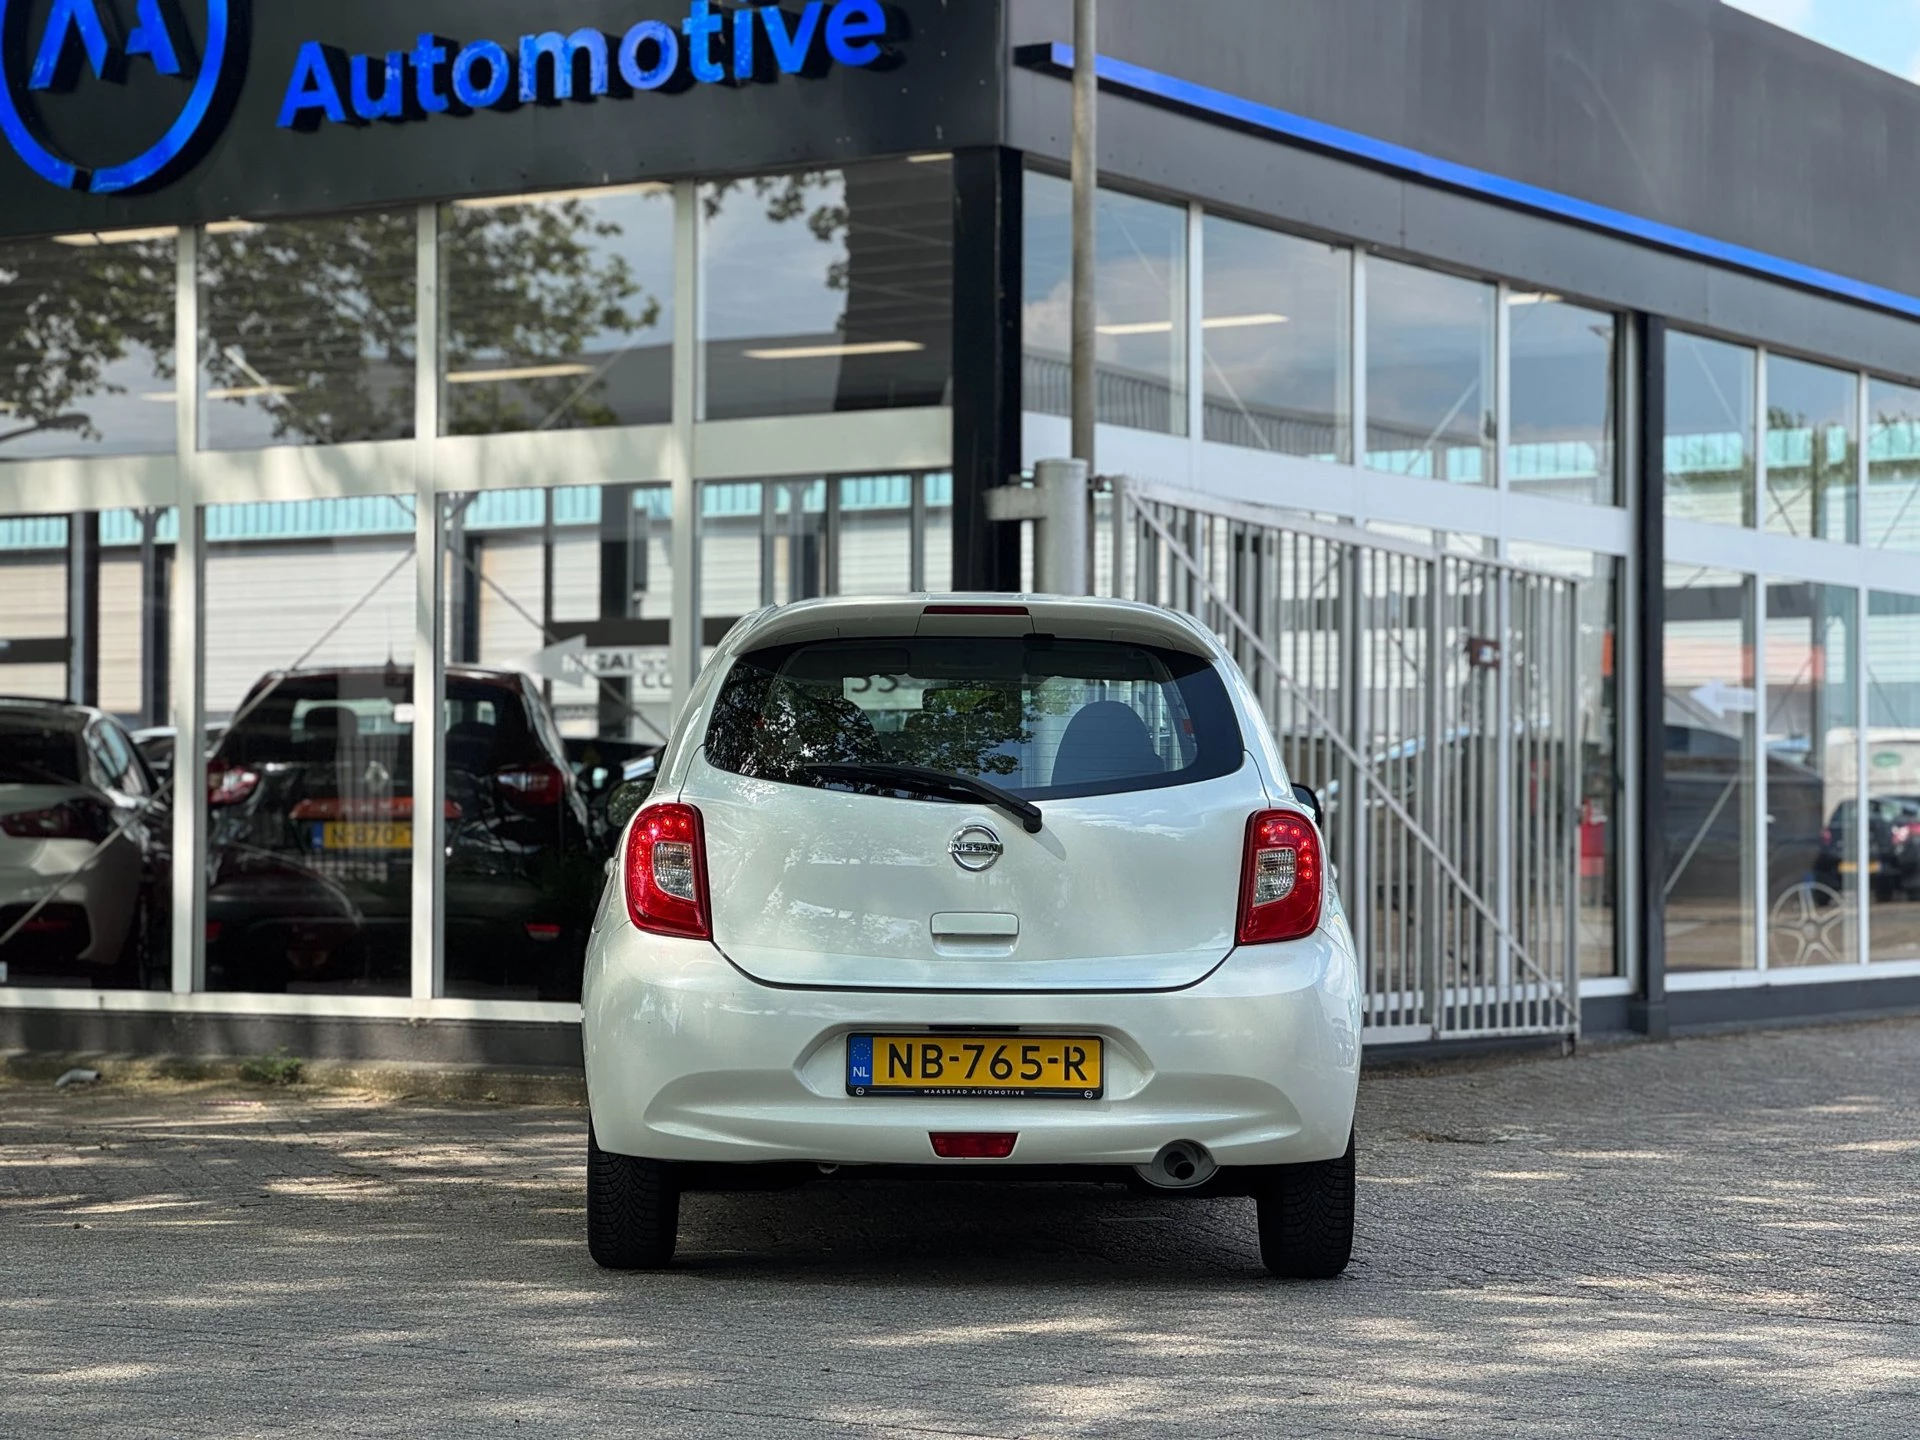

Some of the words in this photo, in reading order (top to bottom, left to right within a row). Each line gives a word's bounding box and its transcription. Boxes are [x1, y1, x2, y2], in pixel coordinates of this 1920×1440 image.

[276, 0, 887, 129] Automotive
[953, 843, 997, 851] NISSAN
[853, 1066, 870, 1077] NL
[888, 1043, 1087, 1081] NB-765-R
